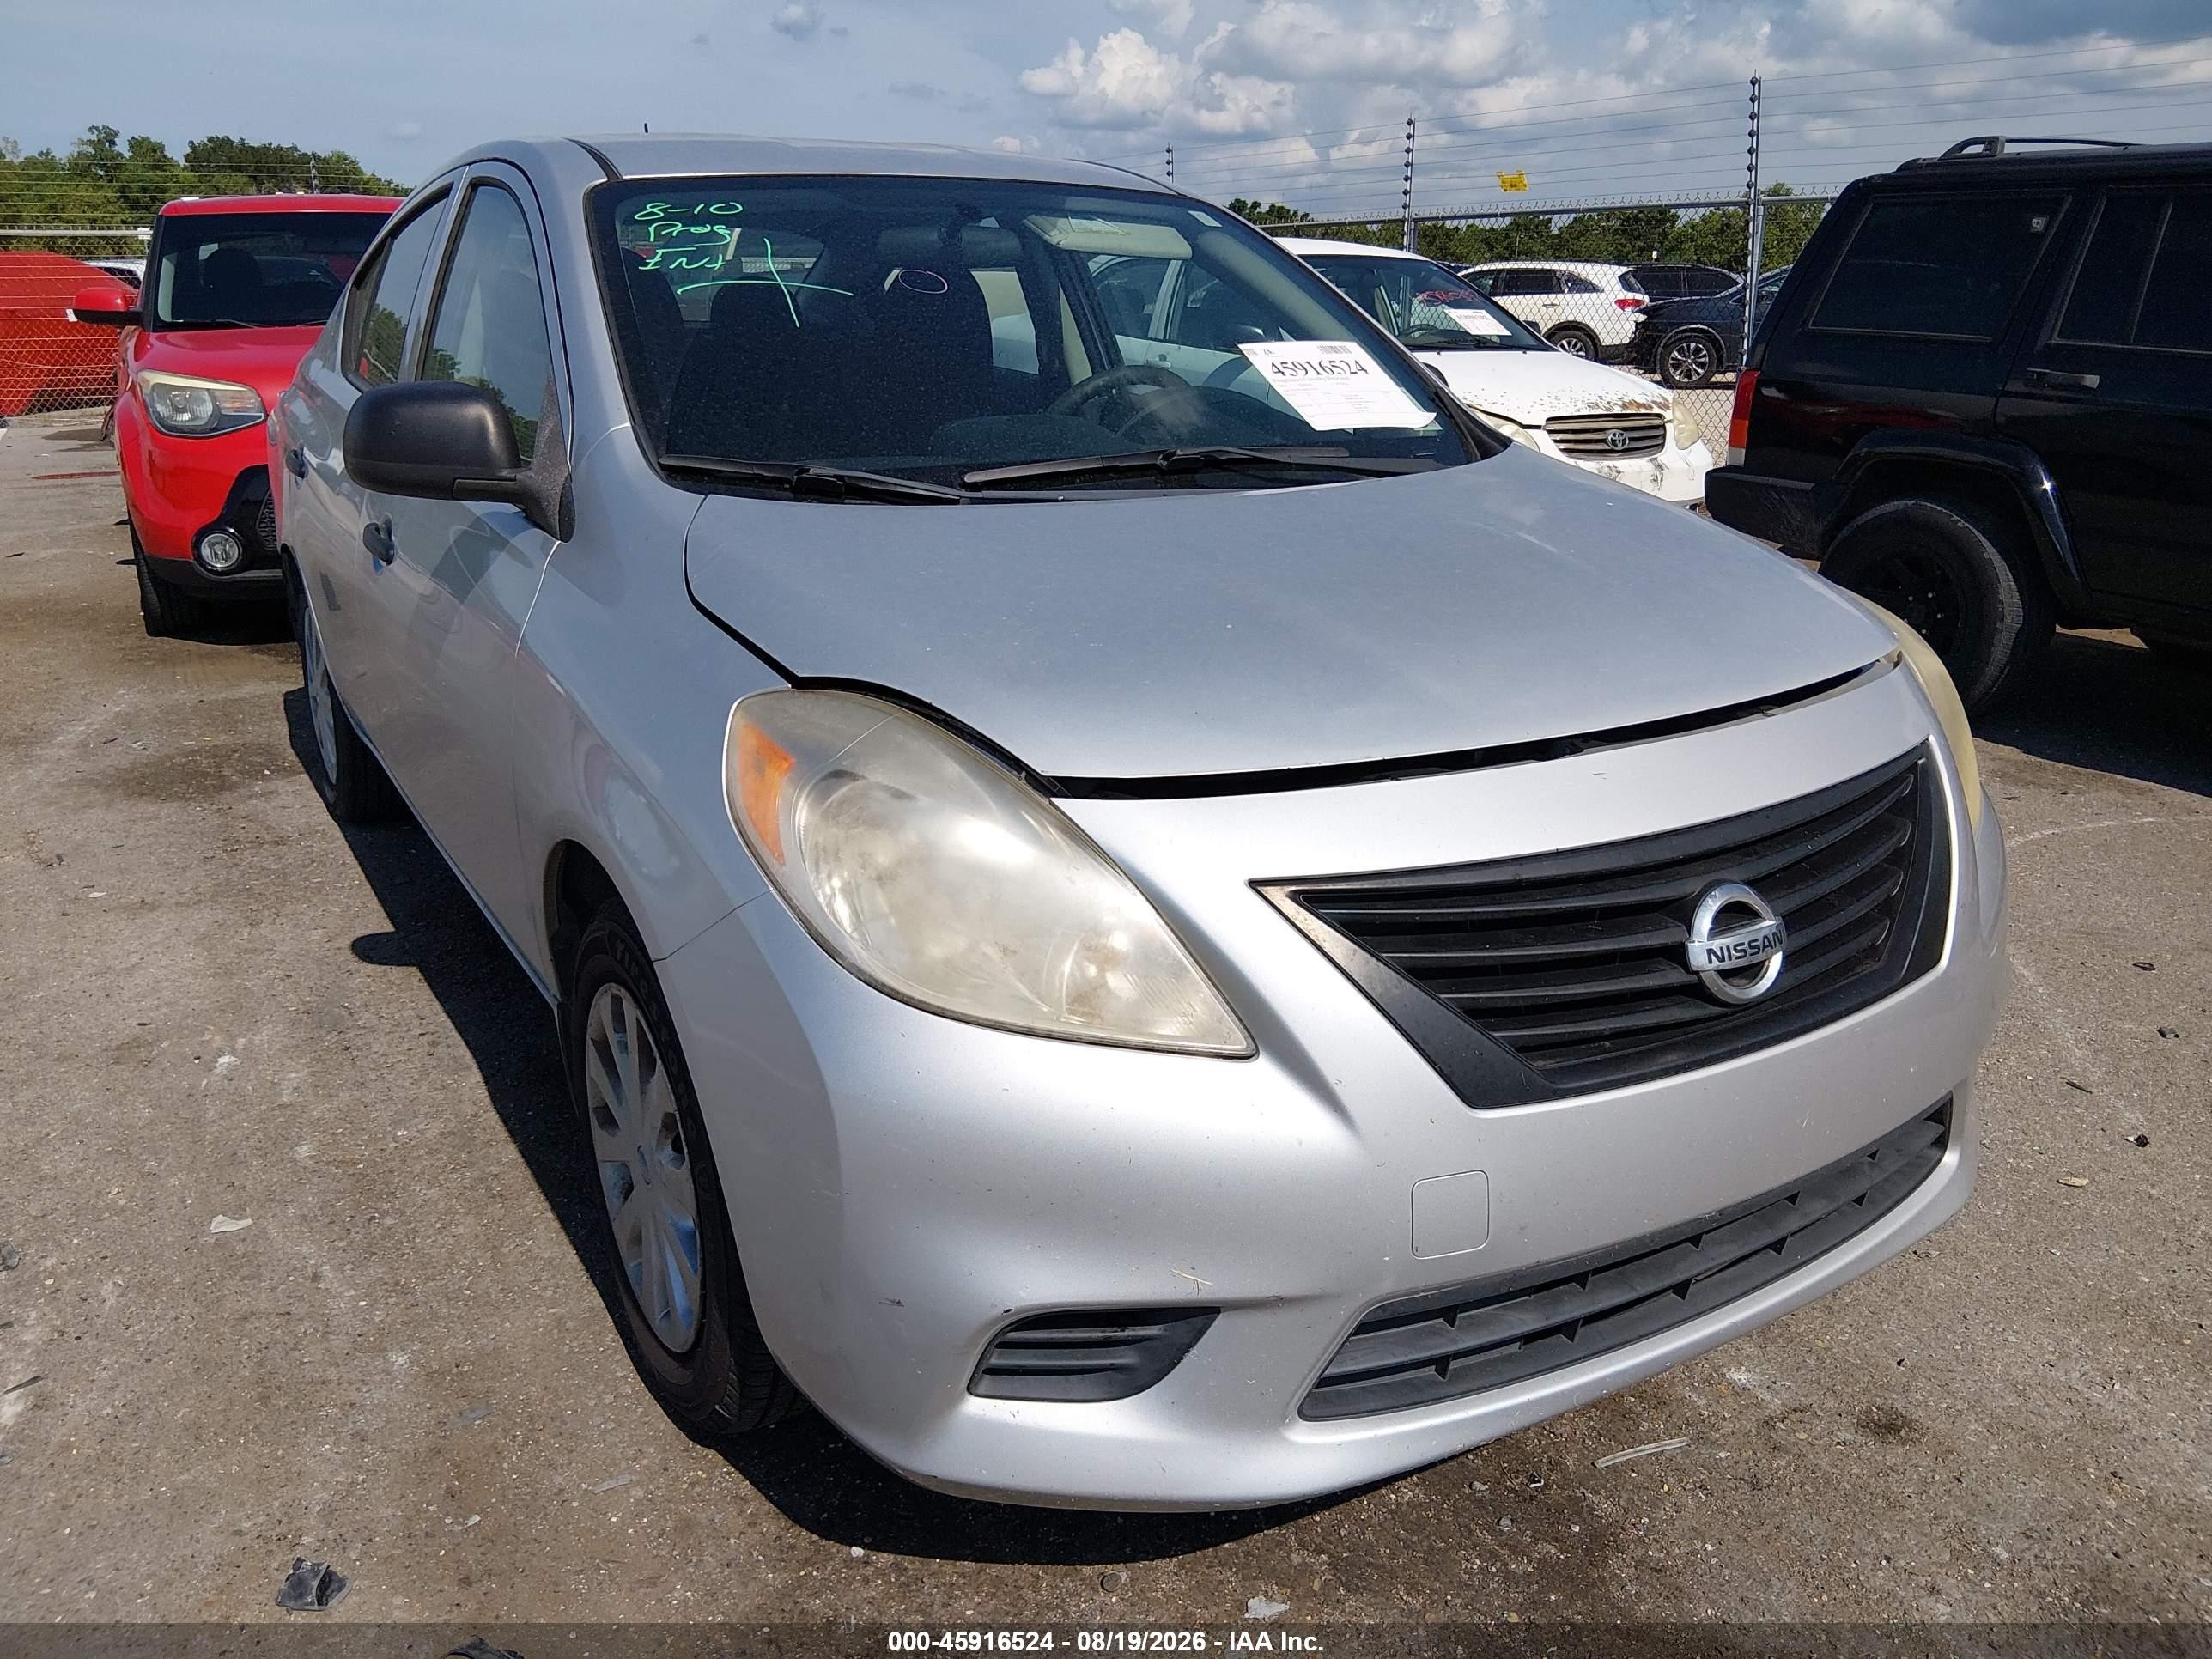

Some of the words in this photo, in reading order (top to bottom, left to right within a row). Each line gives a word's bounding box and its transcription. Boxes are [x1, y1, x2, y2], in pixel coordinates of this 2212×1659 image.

[634, 202, 744, 220] 8-10
[1271, 359, 1370, 377] 45916524
[1705, 931, 1784, 964] NISSAN
